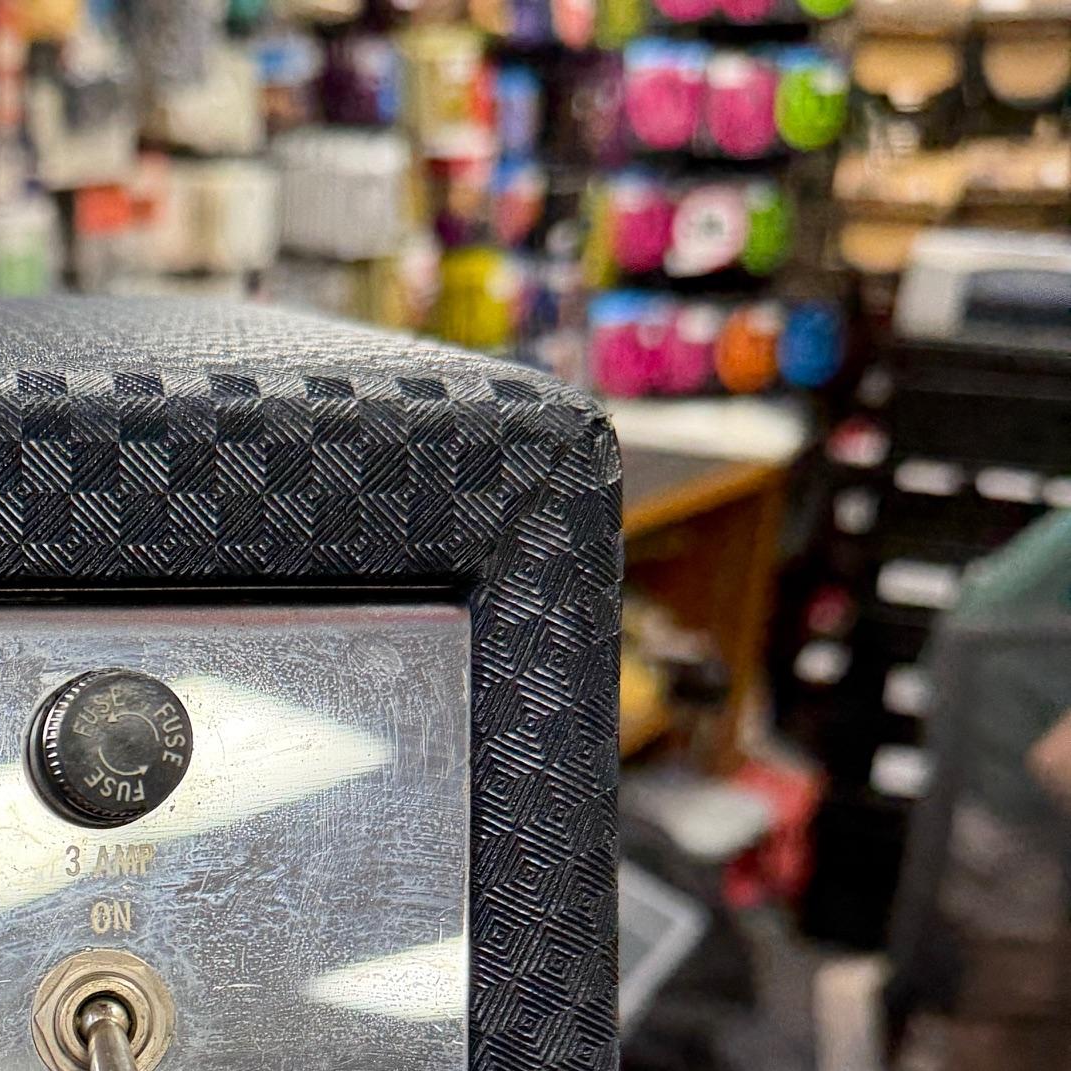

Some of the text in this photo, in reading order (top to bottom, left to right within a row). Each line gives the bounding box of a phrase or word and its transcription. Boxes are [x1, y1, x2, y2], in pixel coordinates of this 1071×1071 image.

[72, 686, 125, 738] FUSE
[153, 702, 186, 768] FUSE
[84, 766, 146, 802] FUSE
[65, 843, 155, 877] 3 AMP
[90, 900, 132, 935] ON
